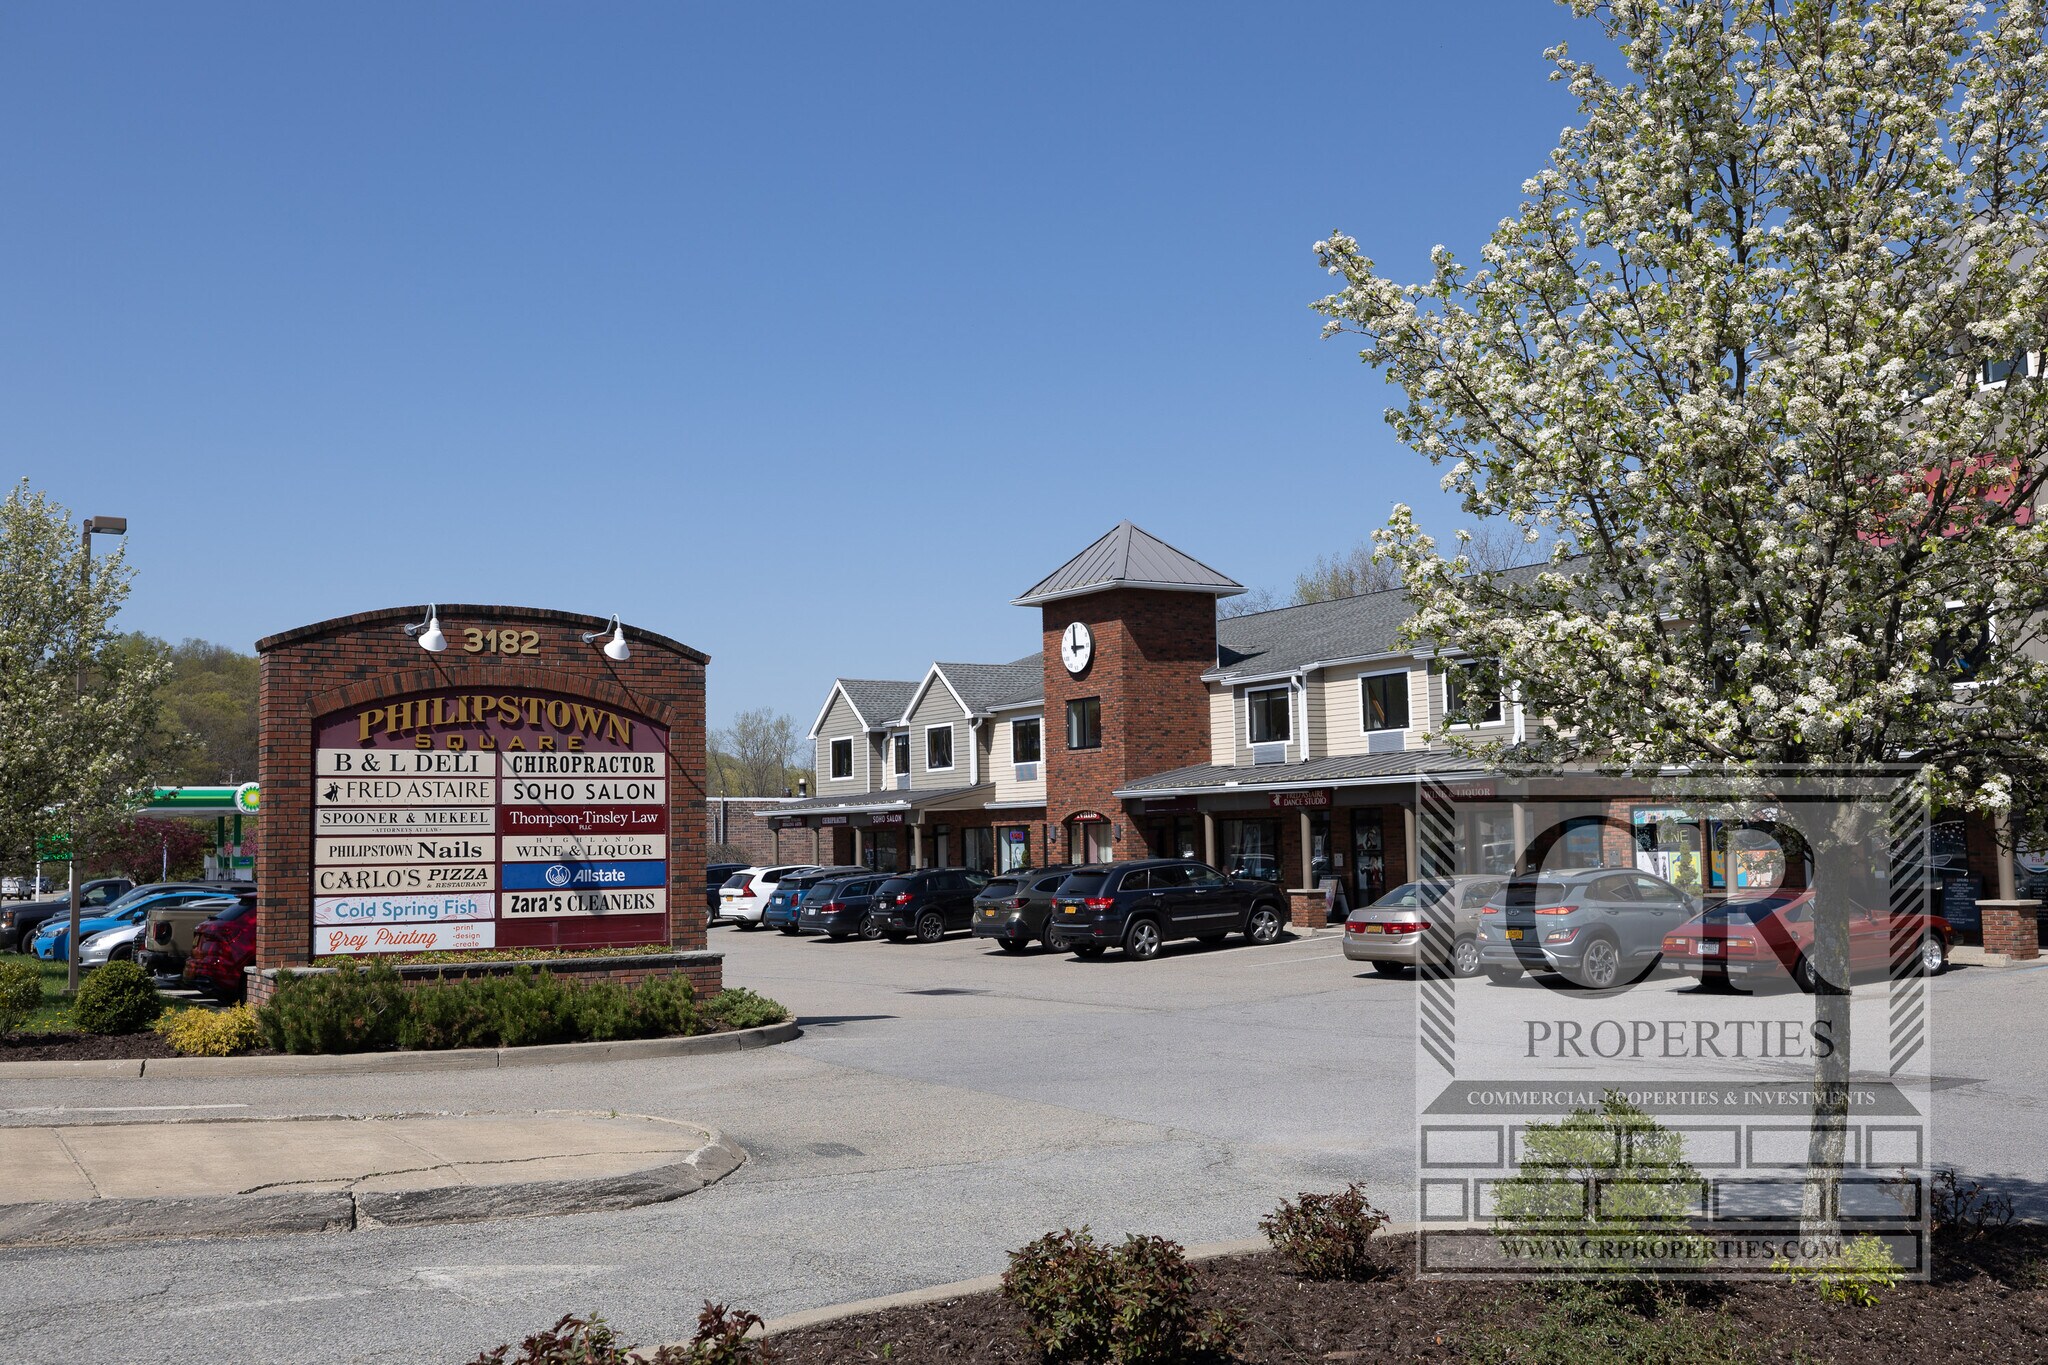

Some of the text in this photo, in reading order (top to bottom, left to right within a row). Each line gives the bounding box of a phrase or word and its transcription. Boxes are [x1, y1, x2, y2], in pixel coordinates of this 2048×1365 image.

[463, 627, 540, 655] 3182
[357, 694, 634, 745] PHILIPSTOWN
[415, 734, 583, 750] SQUARE
[334, 753, 479, 773] B & L DELI
[513, 755, 656, 774] CHIROPRACTOR
[347, 780, 490, 798] FRED ASTAIRE
[514, 783, 655, 800] SOHO SALON
[1424, 791, 1447, 799] WINE
[1457, 788, 1491, 798] LIQUOR
[1284, 797, 1327, 806] DANCE STUDIO
[322, 812, 488, 824] SPOONER & MEKEEL
[509, 810, 658, 827] Thompson-Tinsley Law
[872, 815, 902, 824] SOHO SALON
[1656, 828, 1688, 843] WNE
[329, 841, 482, 858] PHILIPSTOWN Nails
[516, 844, 653, 858] WINE & LIQUOR
[320, 868, 488, 889] CARLO'S PIZZA
[573, 868, 626, 883] Allstate
[335, 899, 478, 920] Cold Spring Fish
[511, 892, 655, 913] Zara's CLEANERS
[329, 928, 438, 952] Grey Printing
